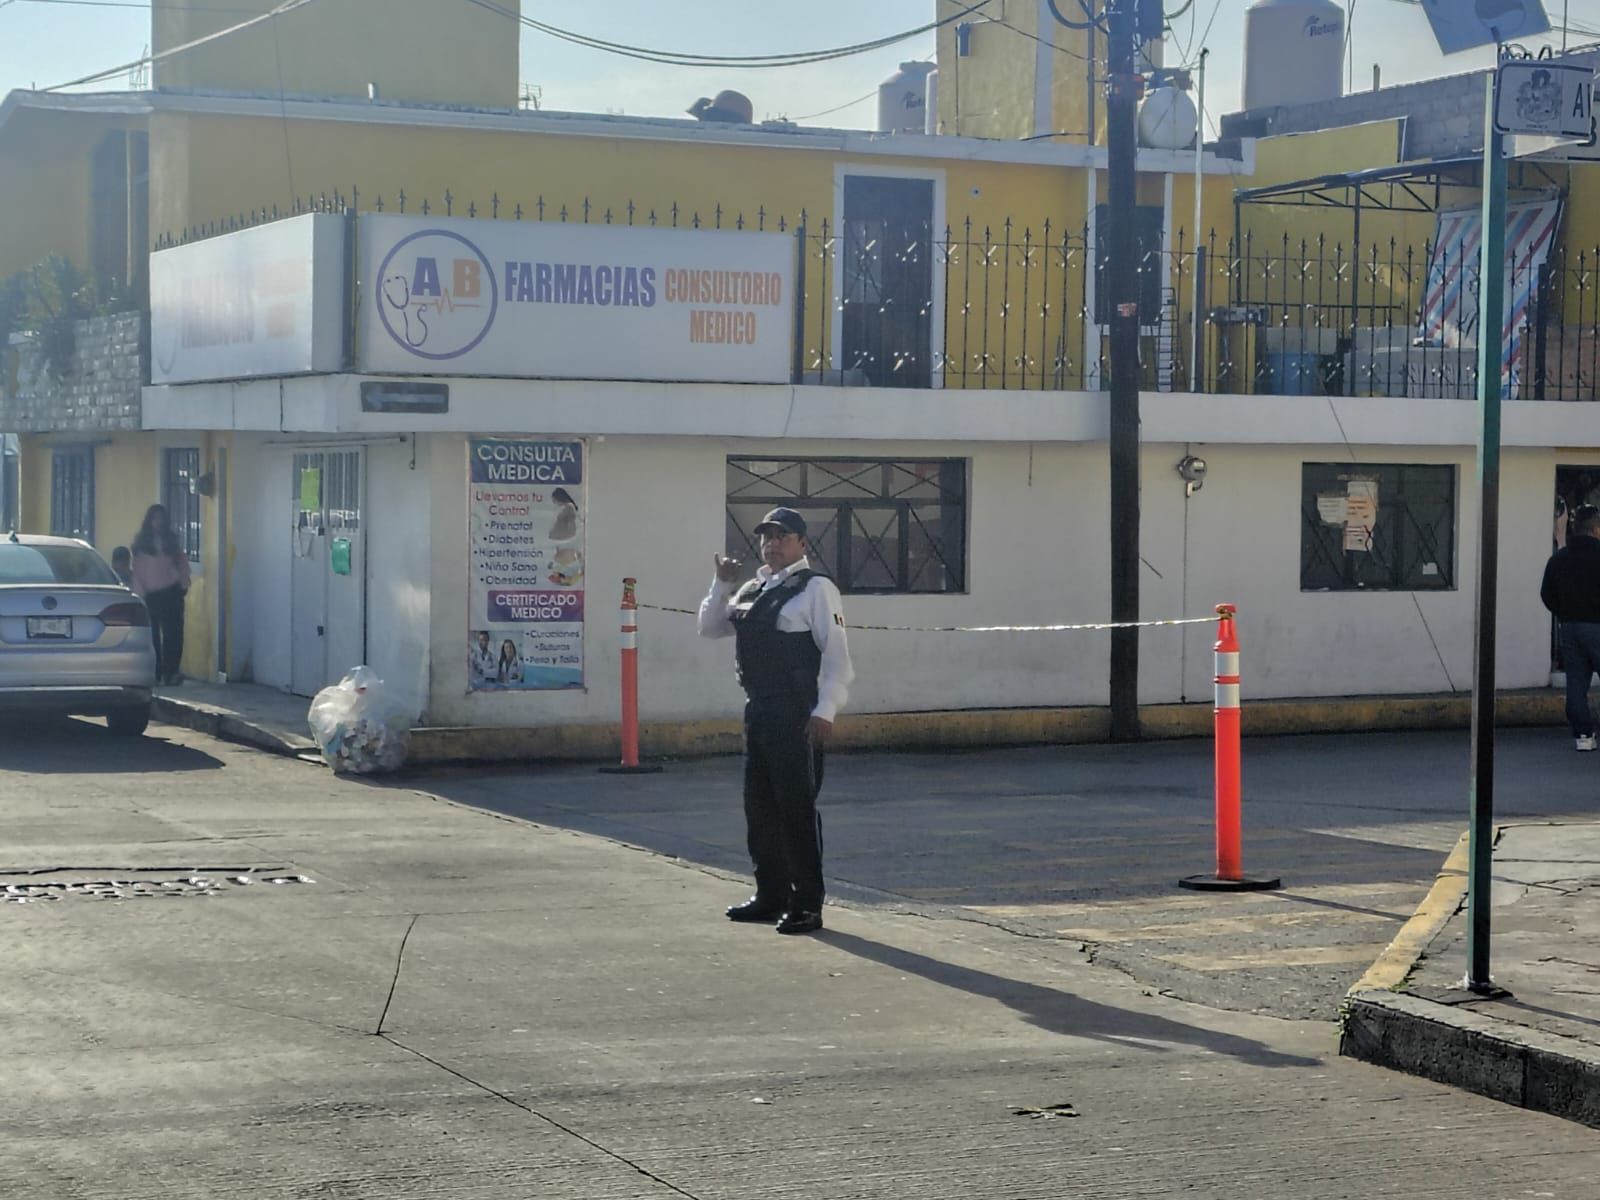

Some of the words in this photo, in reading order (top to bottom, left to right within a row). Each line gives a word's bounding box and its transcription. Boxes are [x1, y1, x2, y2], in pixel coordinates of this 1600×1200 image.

[505, 261, 657, 308] FARMACIAS
[664, 267, 782, 306] CONSULTORIO
[690, 310, 756, 345] MEDICO
[477, 444, 575, 463] CONSULTA
[488, 463, 566, 481] MEDICA
[476, 491, 529, 502] Llevamos
[532, 492, 543, 503] tu
[489, 505, 530, 516] Control
[490, 520, 533, 530] Prenatal
[488, 534, 534, 544] Diabetes
[511, 561, 538, 571] Sano
[485, 575, 537, 585] Obesidad
[495, 594, 577, 606] CERTIFICADO
[511, 607, 562, 619] MEDICO
